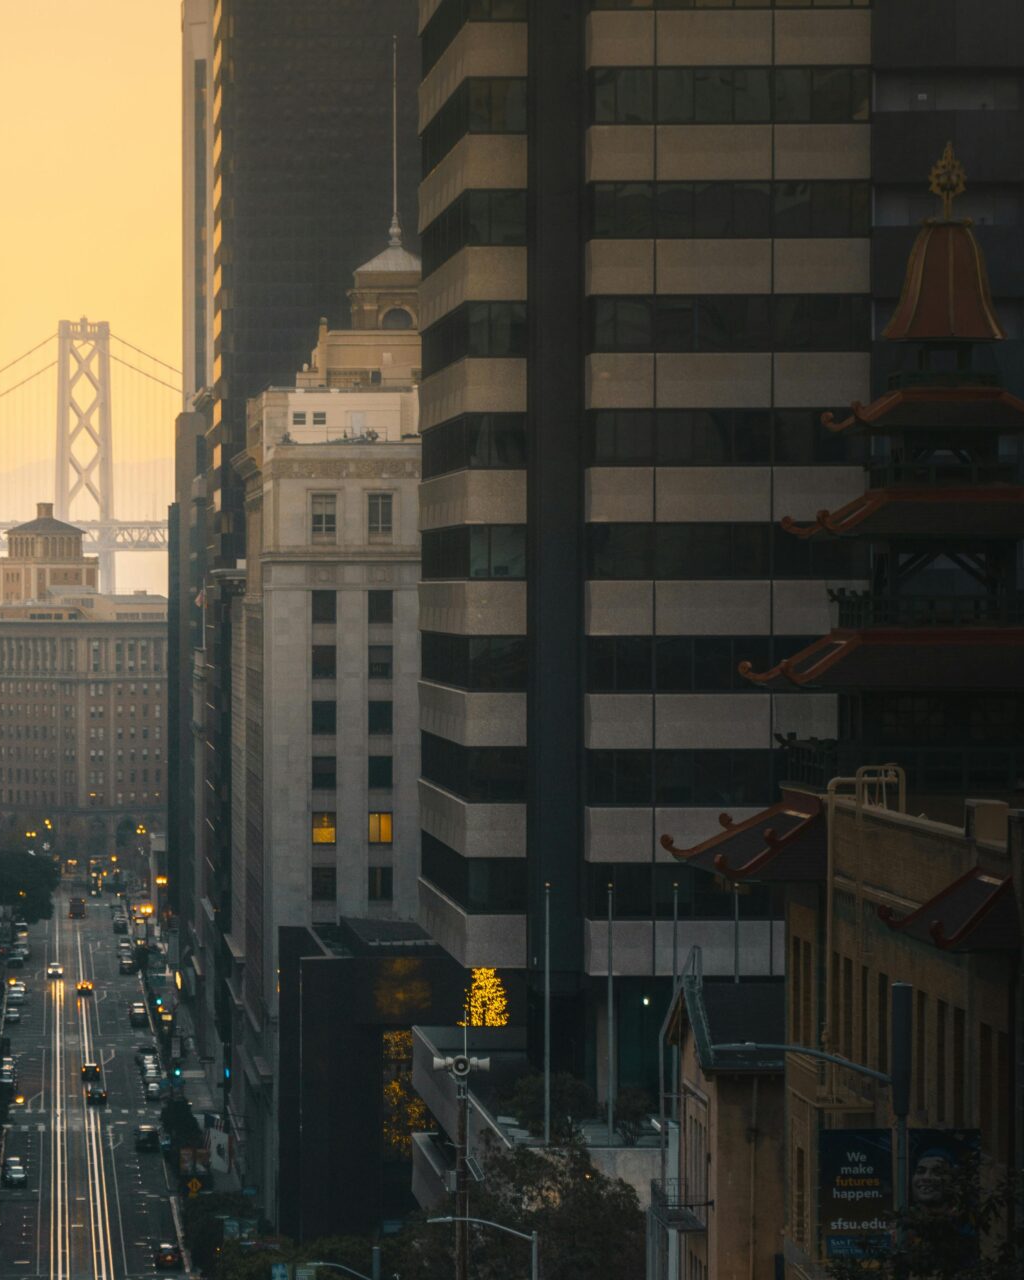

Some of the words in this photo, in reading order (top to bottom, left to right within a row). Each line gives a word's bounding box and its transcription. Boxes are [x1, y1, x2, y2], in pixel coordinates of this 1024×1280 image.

[846, 1151, 867, 1162] We
[840, 1163, 874, 1174] make
[836, 1175, 880, 1187] futures
[832, 1188, 883, 1201] happen.
[830, 1217, 887, 1230] sfsu.edu
